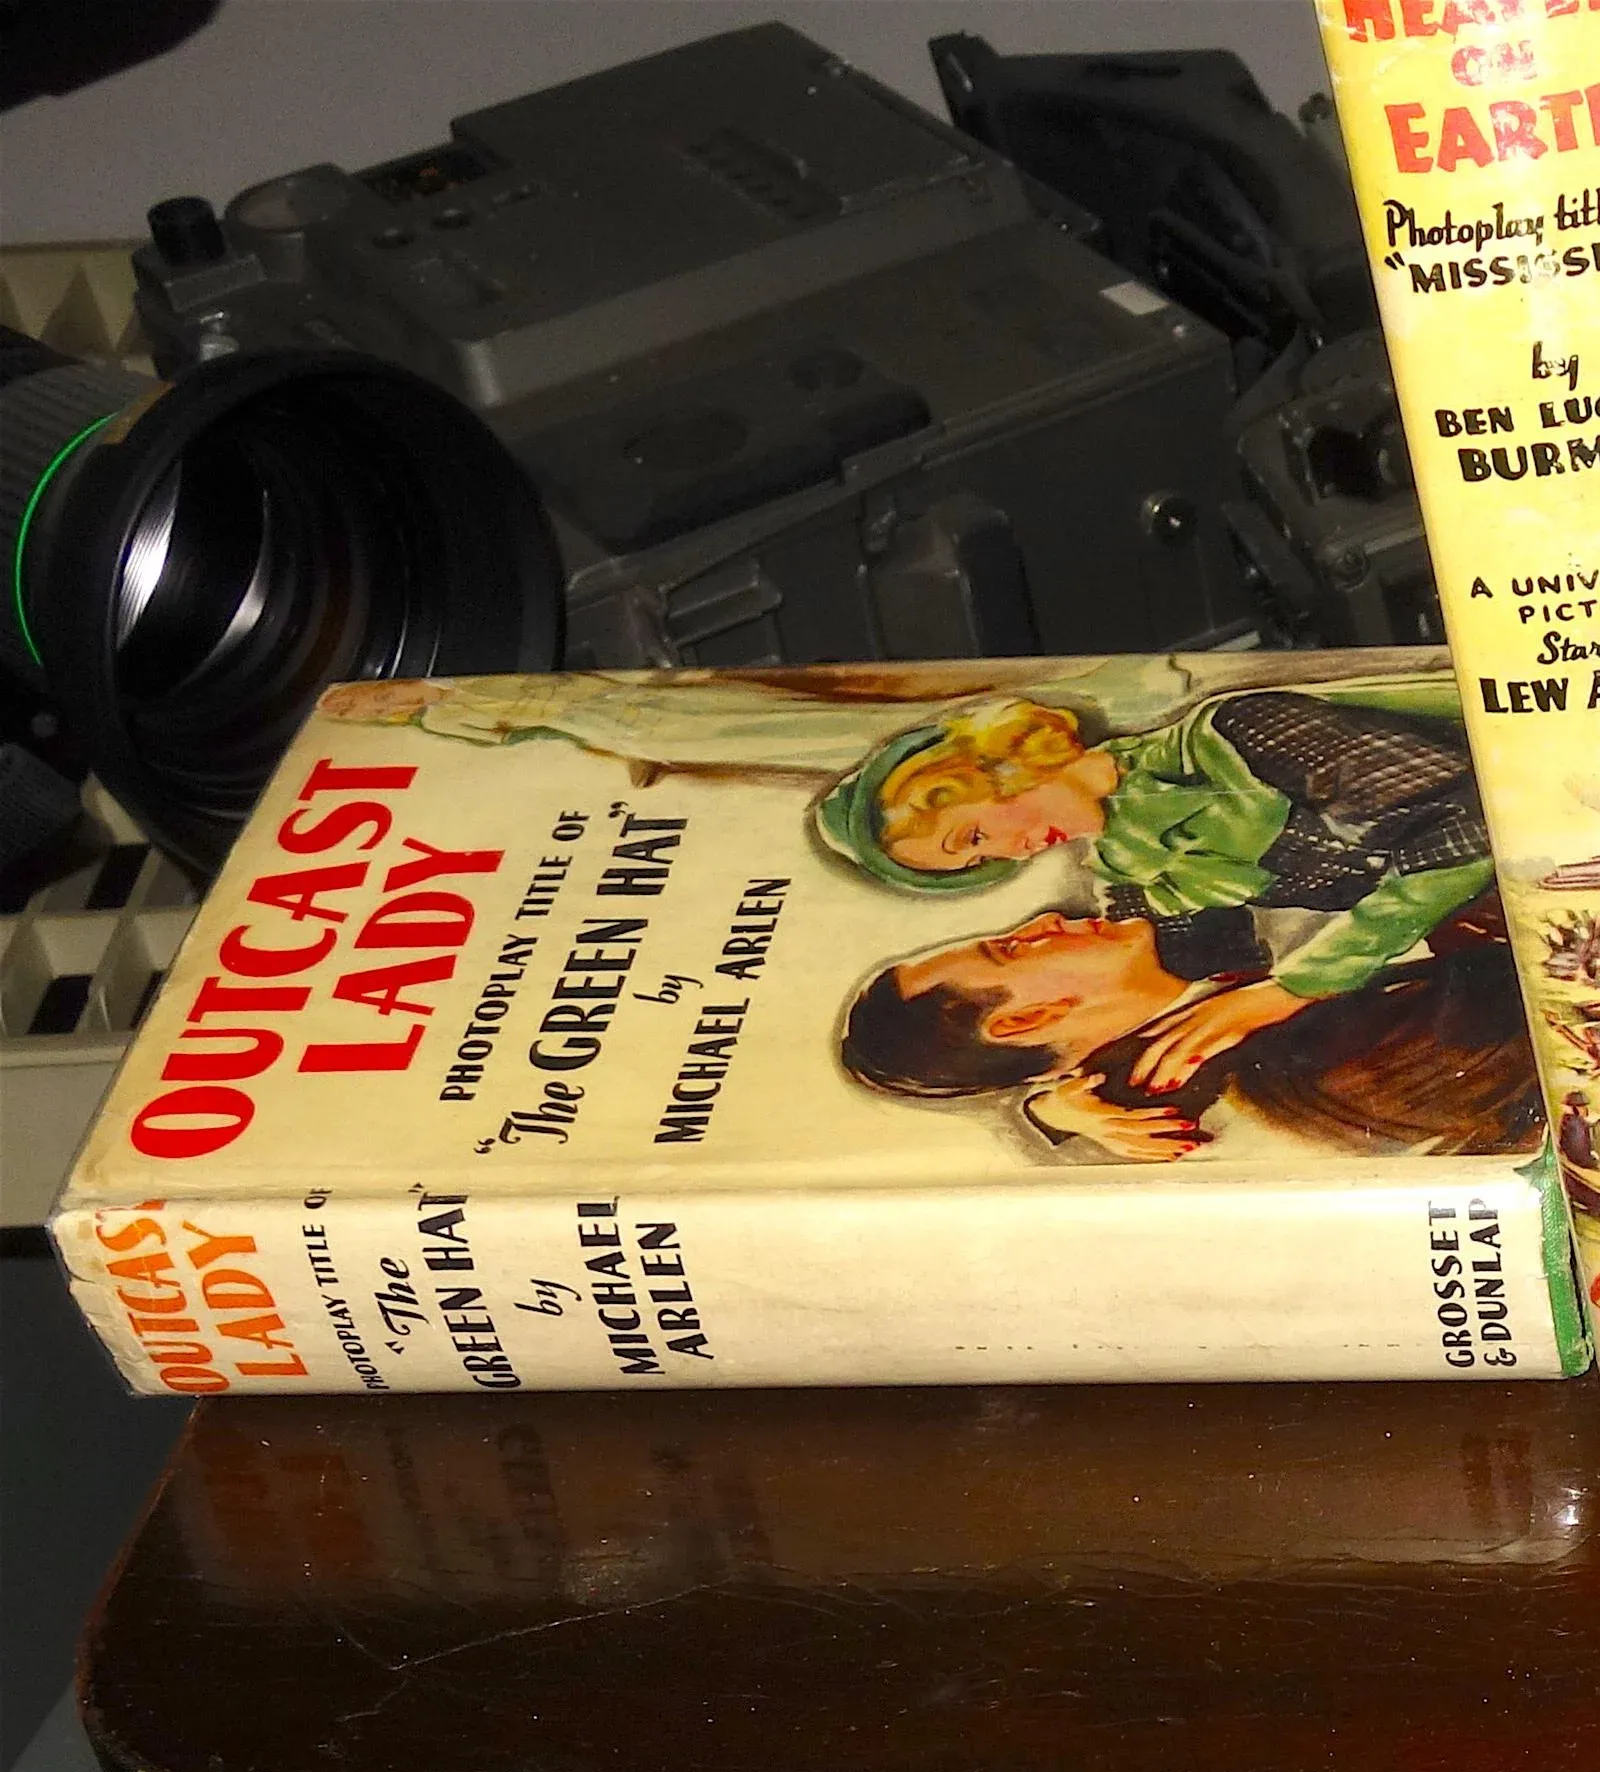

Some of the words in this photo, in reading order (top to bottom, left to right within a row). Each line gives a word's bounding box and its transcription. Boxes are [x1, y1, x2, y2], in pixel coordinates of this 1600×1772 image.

[1383, 197, 1544, 248] Photoplay
[1531, 340, 1578, 389] by
[1434, 408, 1515, 438] BEN
[1470, 576, 1494, 599] A
[1479, 677, 1569, 715] LEW
[131, 758, 418, 1159] OUTCAST
[297, 838, 505, 1073] LADY
[441, 933, 538, 1102] PHOTOPLAY
[516, 850, 570, 921] TITLE
[553, 809, 589, 844] OF
[529, 918, 648, 1070] GREEN
[596, 802, 687, 895] HAT"
[634, 973, 703, 1006] by
[655, 999, 750, 1145] MICHAEL
[714, 878, 791, 980] ARLEN
[304, 1188, 333, 1209] OF
[182, 1220, 308, 1376] LADY
[302, 1224, 336, 1287] TITLE
[513, 1278, 582, 1317] by
[576, 1195, 665, 1374] MICHAEL
[635, 1222, 714, 1359] ARLEN
[1428, 1200, 1475, 1368] GROSSET
[1468, 1198, 1512, 1342] DUNLAP
[321, 1294, 390, 1391] PHOTOPLAY
[435, 1287, 521, 1388] GREEN
[1484, 1347, 1517, 1367] &
